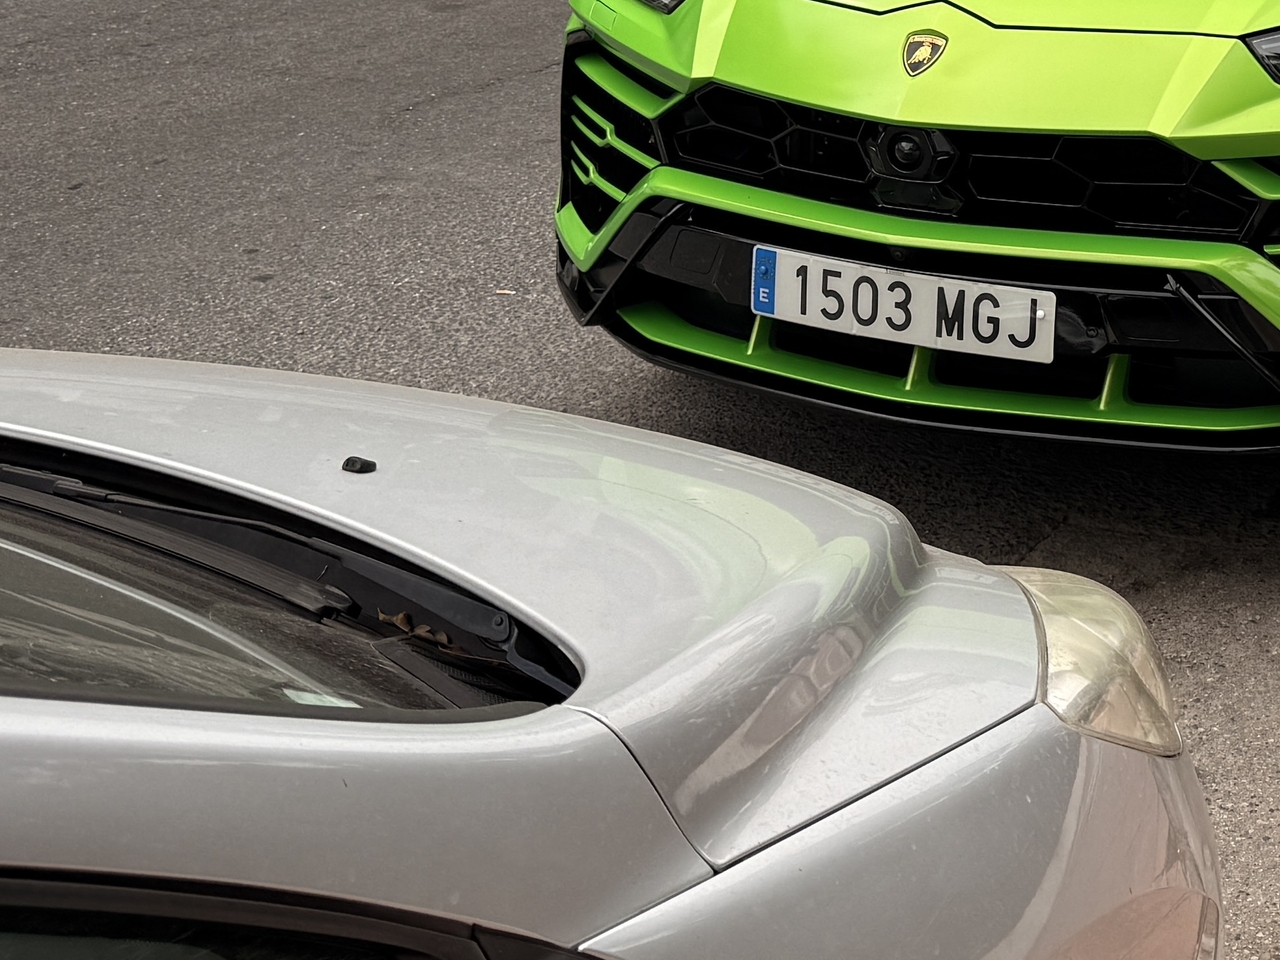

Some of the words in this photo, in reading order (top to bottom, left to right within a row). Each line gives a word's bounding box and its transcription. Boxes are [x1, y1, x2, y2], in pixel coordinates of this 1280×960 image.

[759, 287, 769, 302] E
[796, 265, 912, 331] 1503
[935, 286, 1038, 349] MGJ
